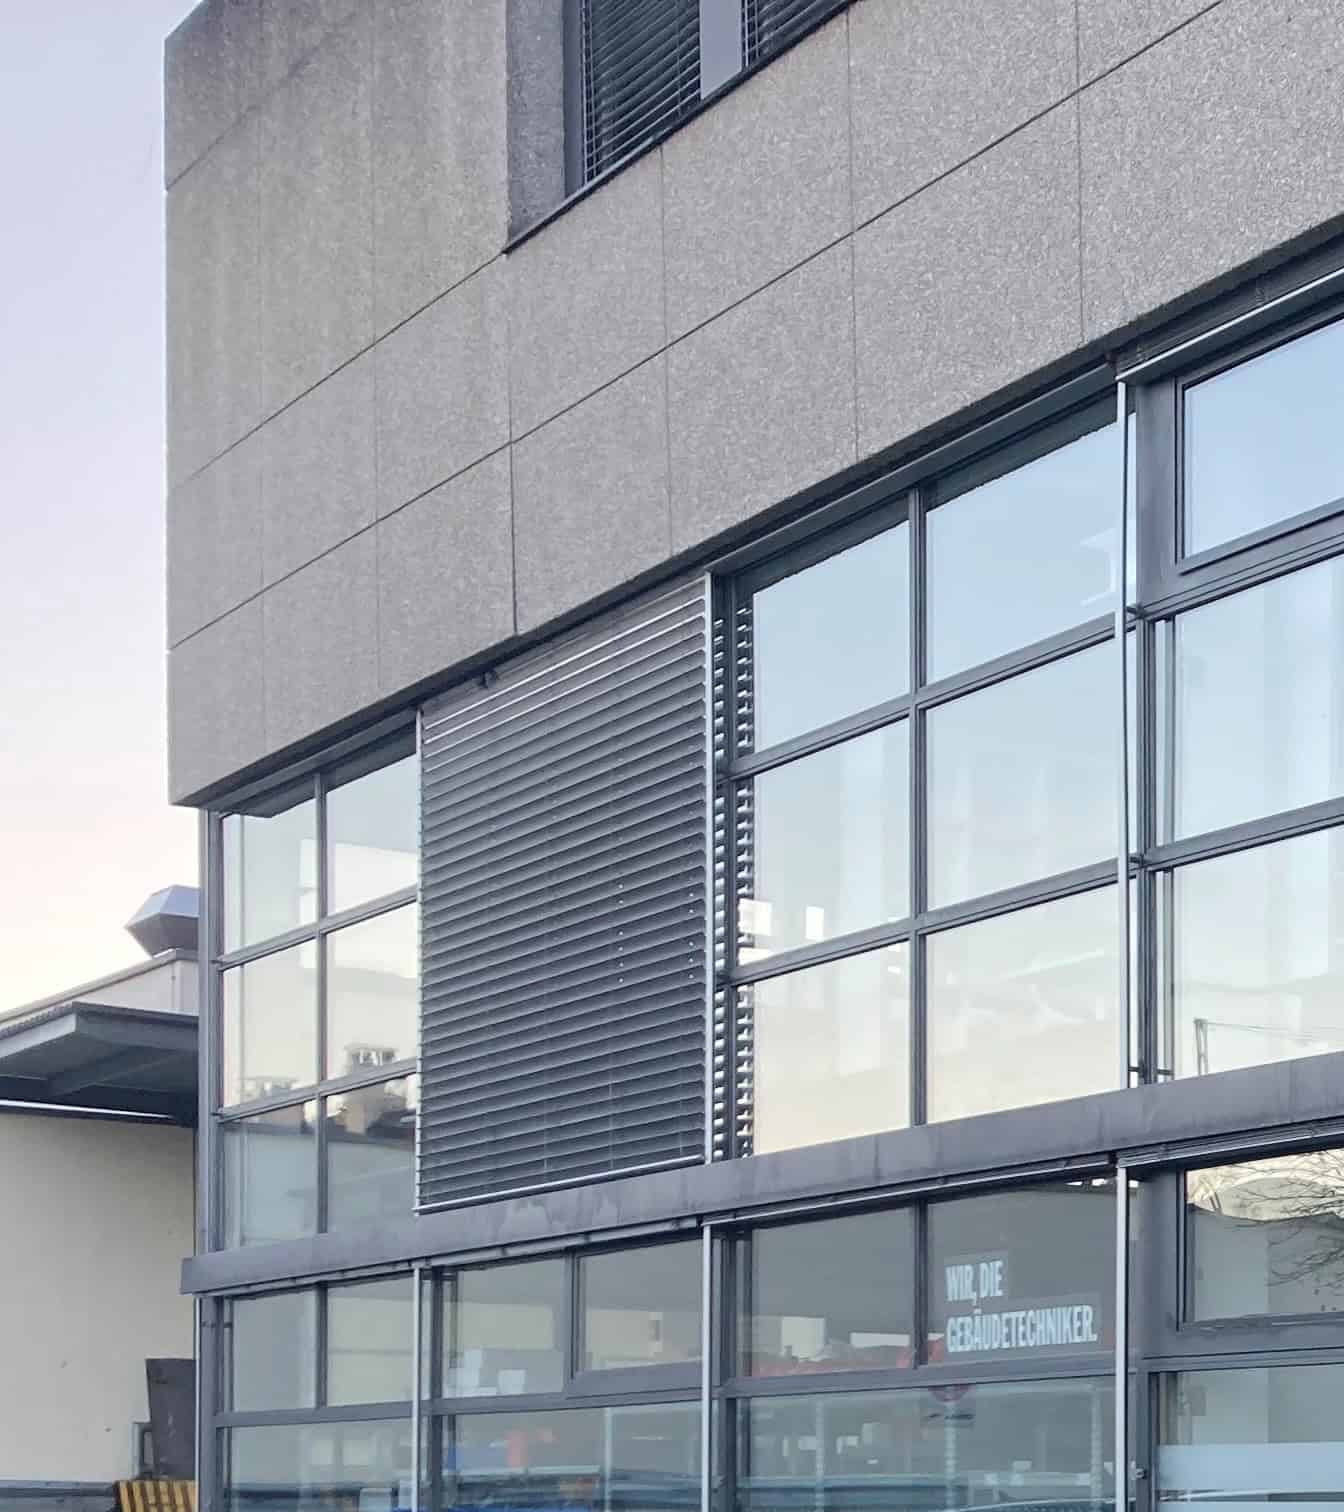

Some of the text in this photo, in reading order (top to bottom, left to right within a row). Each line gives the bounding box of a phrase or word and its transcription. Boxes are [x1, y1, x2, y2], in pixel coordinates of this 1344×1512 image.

[946, 1260, 1003, 1305] WIR, DIE
[946, 1304, 1098, 1353] GEBÄUDETECHNIKER.
